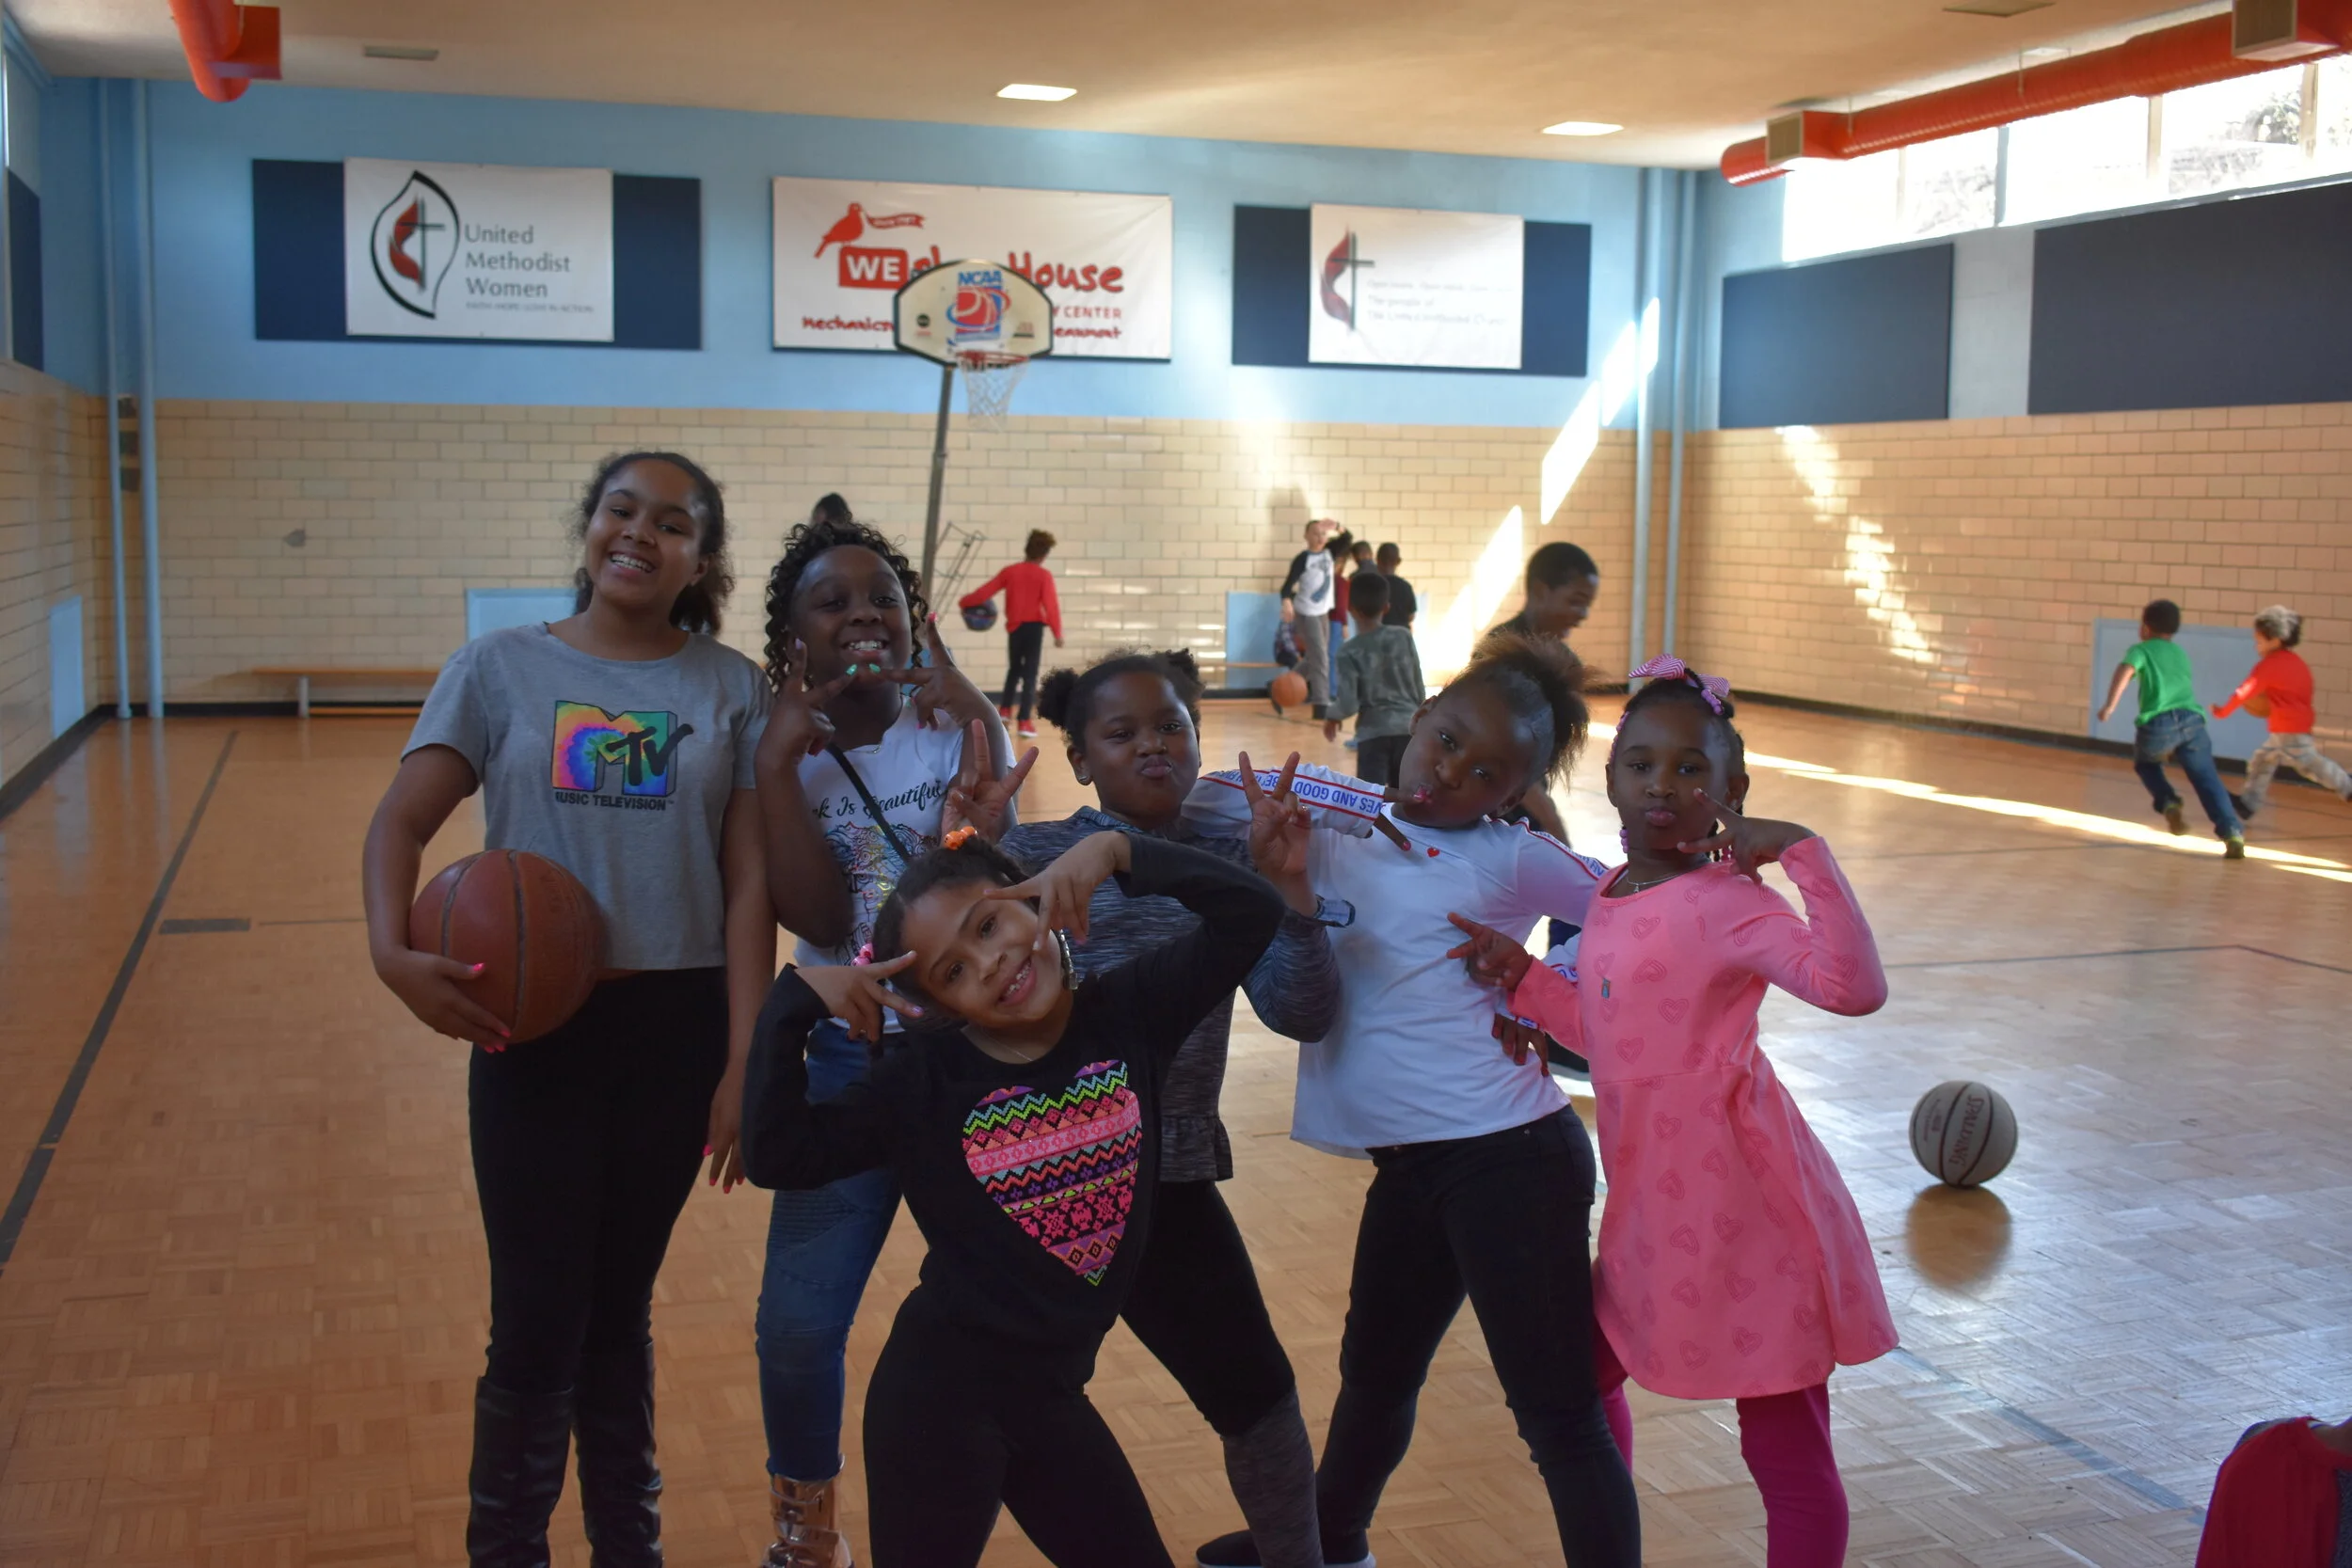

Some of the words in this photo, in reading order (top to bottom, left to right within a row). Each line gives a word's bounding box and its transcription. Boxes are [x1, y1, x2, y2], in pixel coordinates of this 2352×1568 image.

[464, 223, 534, 245] United
[464, 250, 571, 273] Methodist
[958, 270, 1002, 285] NCAA
[1008, 251, 1124, 293] House
[464, 276, 548, 298] Women
[1064, 306, 1122, 319] CENTER
[1053, 325, 1122, 340] eaumont
[551, 700, 694, 798] MTV
[1294, 781, 1329, 800] GOOD
[1331, 789, 1359, 807] AND
[593, 795, 667, 812] TELEVISION
[1359, 798, 1384, 815] VES
[1947, 1094, 1985, 1166] SPALDING
